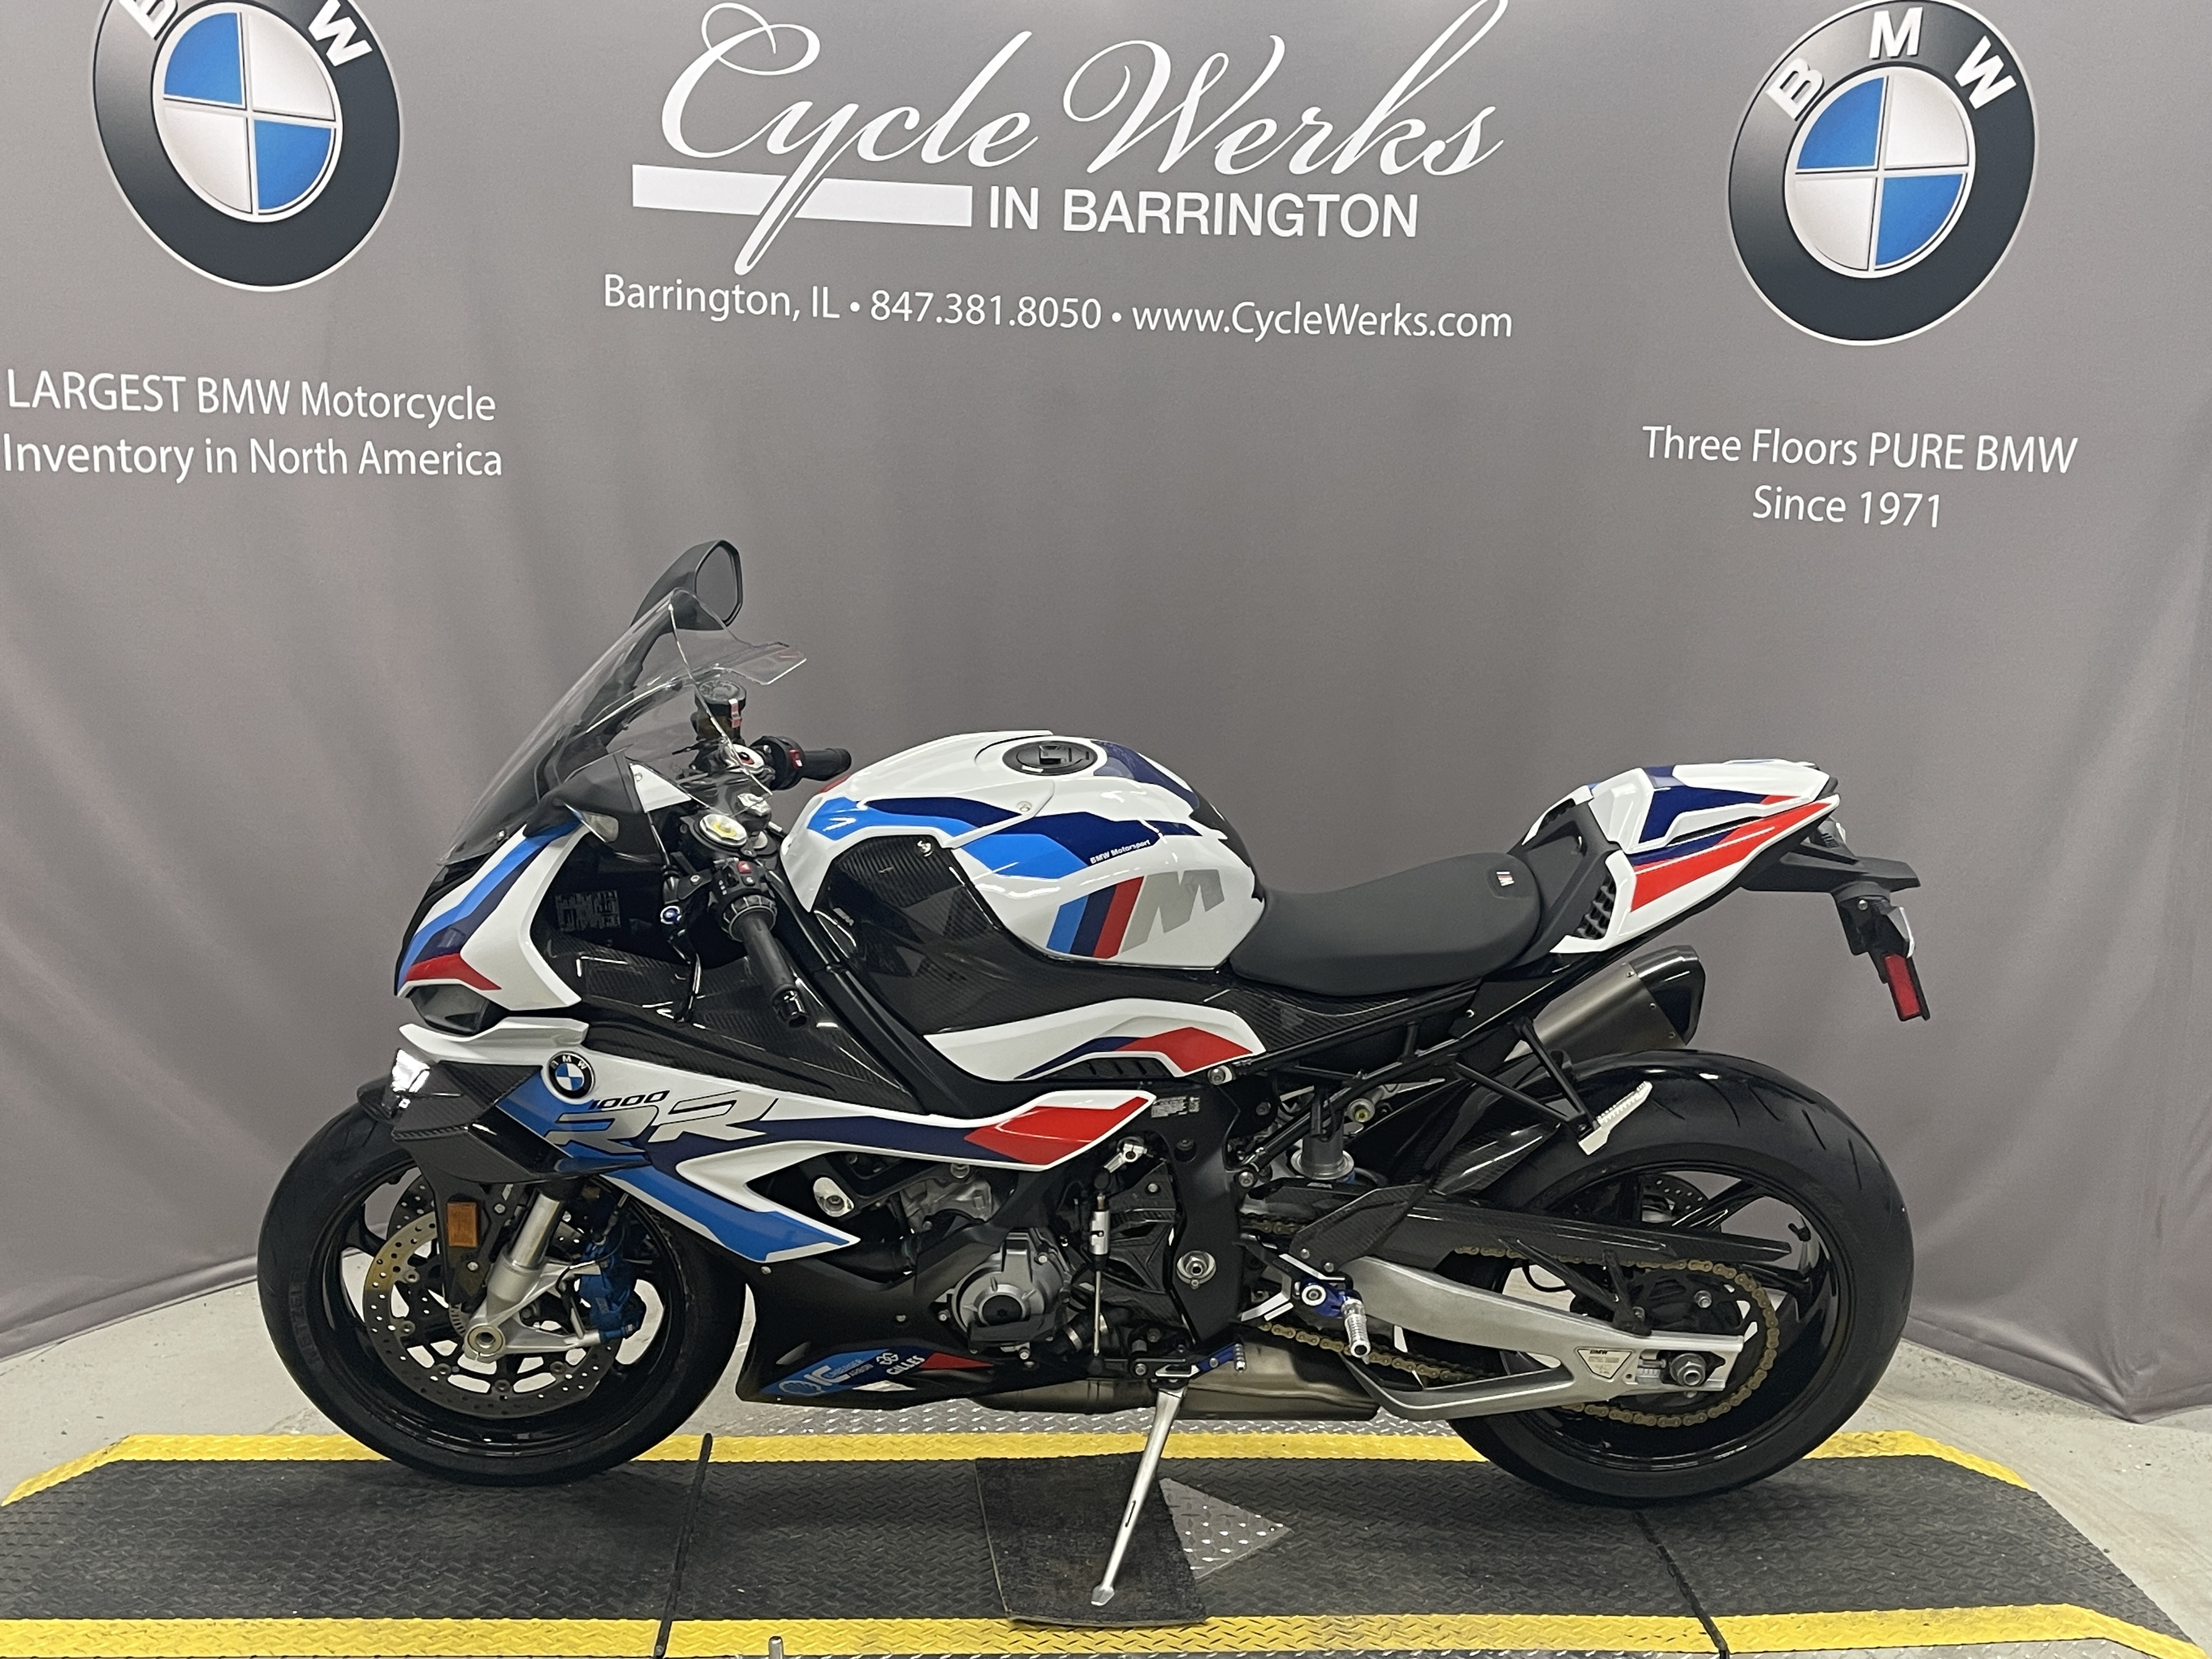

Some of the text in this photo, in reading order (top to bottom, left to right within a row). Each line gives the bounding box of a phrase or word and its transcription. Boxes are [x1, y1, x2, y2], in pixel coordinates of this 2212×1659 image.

[1766, 7, 2017, 121] BMW
[661, 0, 1509, 276] Cycle Werks
[990, 185, 1418, 239] IN BARRINGTON
[605, 273, 1513, 343] Barrington, IL 847.381.8050 www.CycleWerks.com
[7, 368, 496, 430] LARGEST BMW Motorcycle
[3, 433, 502, 484] Inventory in North America
[1641, 424, 2079, 474] Three Floors PURE BMW
[1752, 484, 1940, 528] Since 1971
[1090, 839, 1150, 864] BMW Motorsport
[550, 1055, 588, 1069] BMW
[588, 1090, 669, 1110] 1000
[886, 1355, 925, 1375] GILLES
